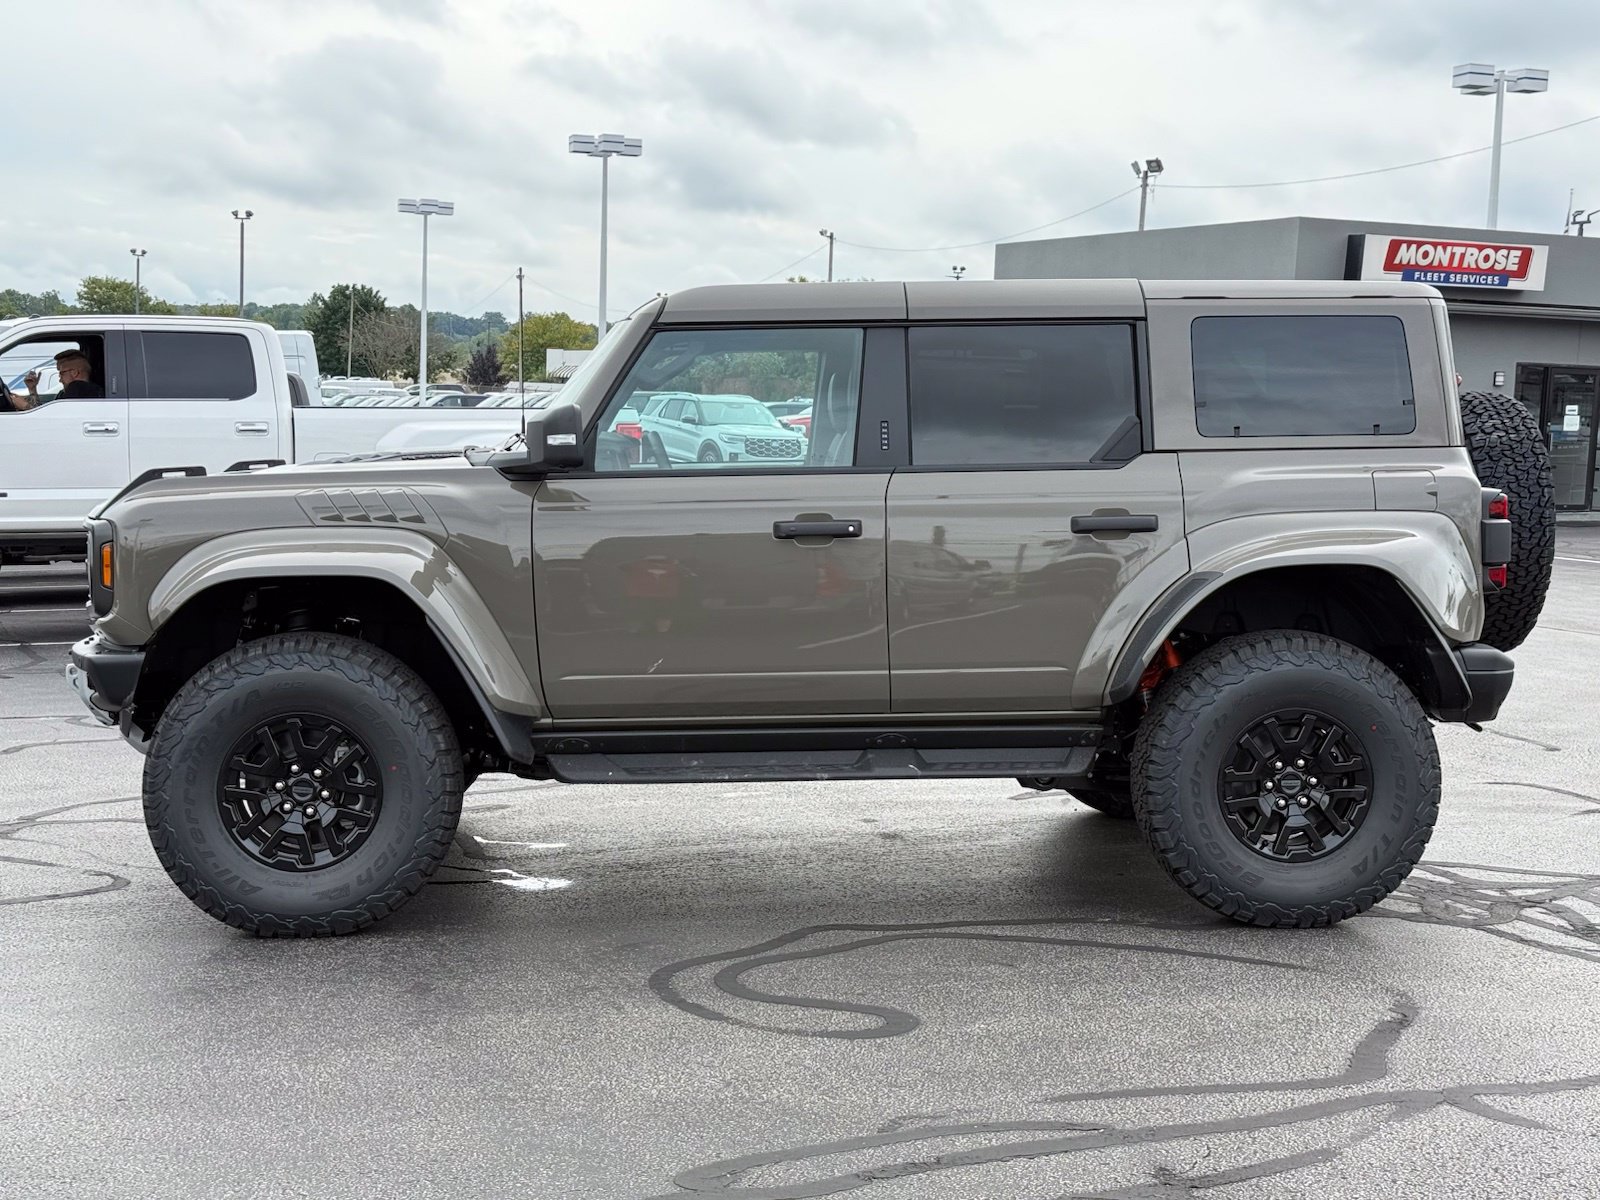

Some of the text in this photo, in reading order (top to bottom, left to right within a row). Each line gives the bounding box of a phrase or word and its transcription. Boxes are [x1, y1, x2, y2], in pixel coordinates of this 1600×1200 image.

[1394, 243, 1522, 271] MONTROSE
[1414, 271, 1500, 284] FLEET SERVICES
